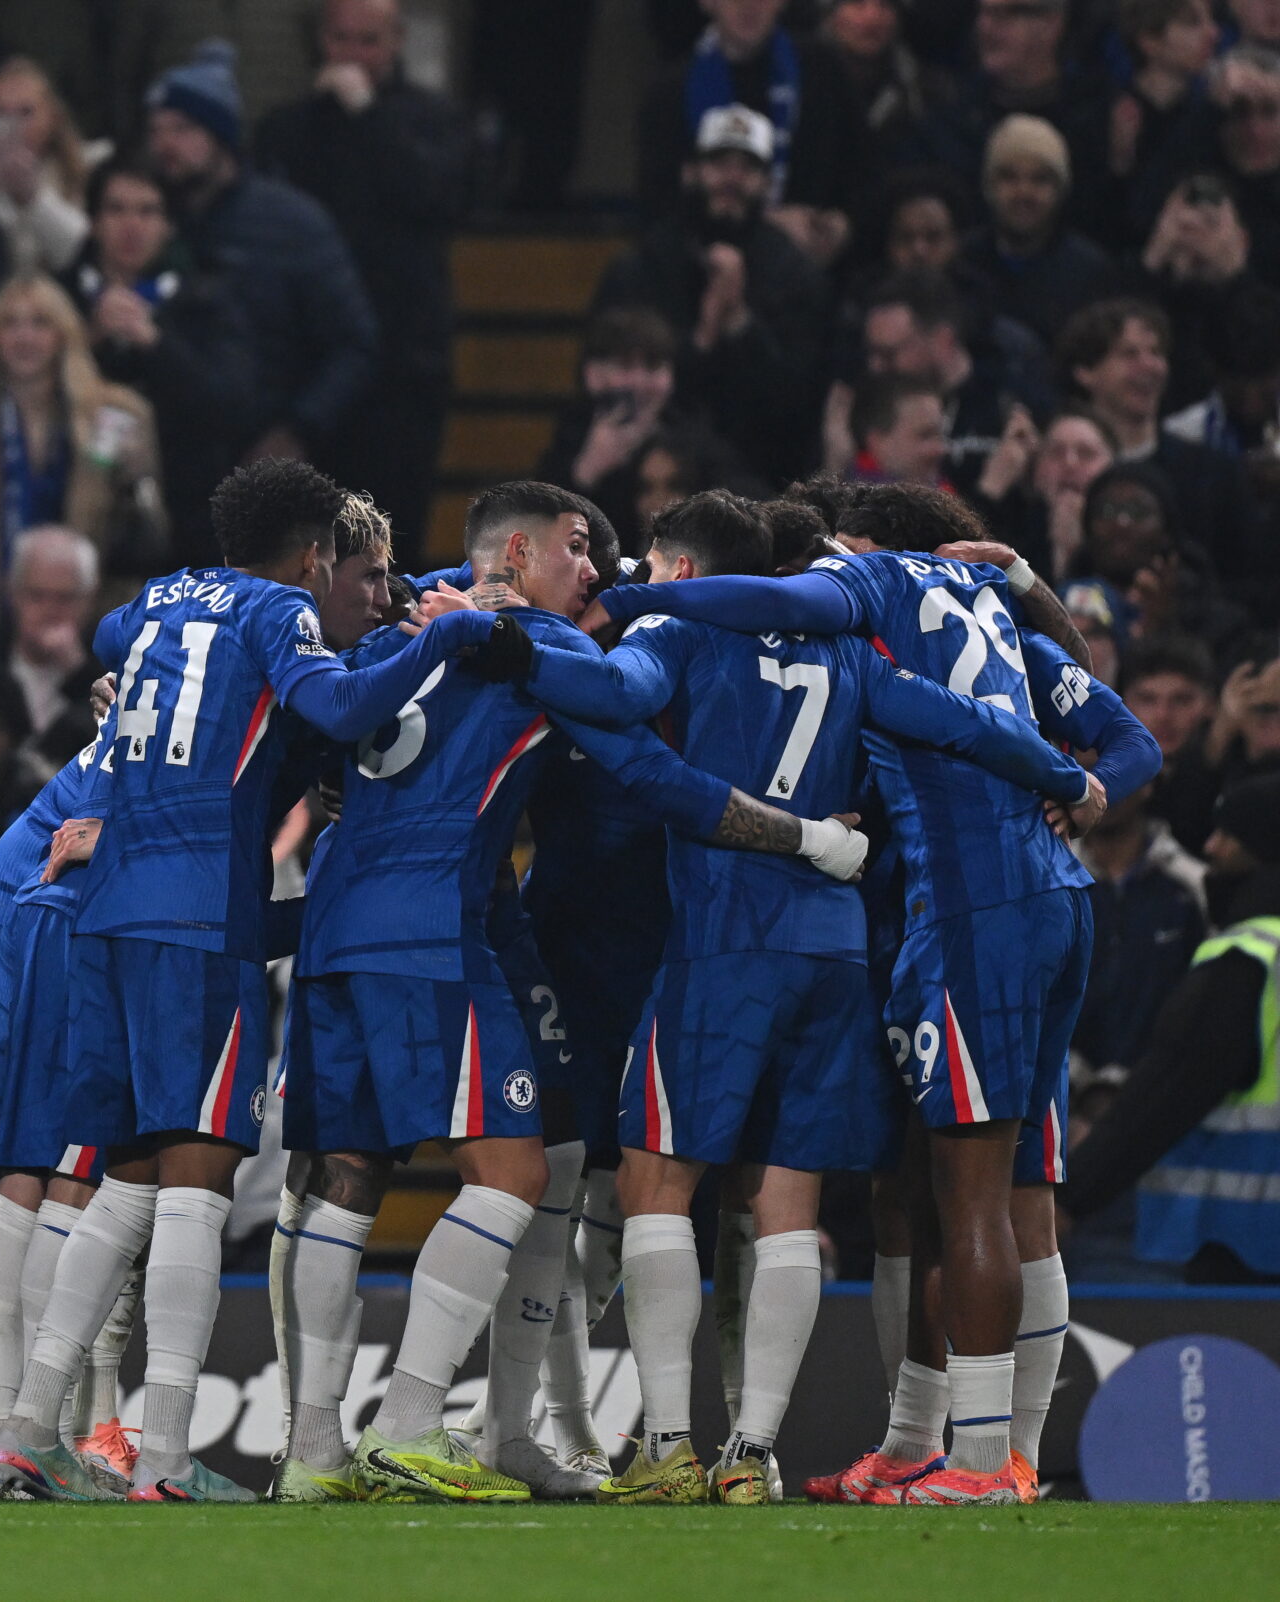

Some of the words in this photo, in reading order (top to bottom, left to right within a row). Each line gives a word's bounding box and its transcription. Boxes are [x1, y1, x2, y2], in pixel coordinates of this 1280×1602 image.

[203, 571, 219, 580] CFC
[113, 620, 220, 767] 41
[918, 585, 1037, 721] 29
[758, 655, 830, 800] 7
[886, 1020, 940, 1087] 29
